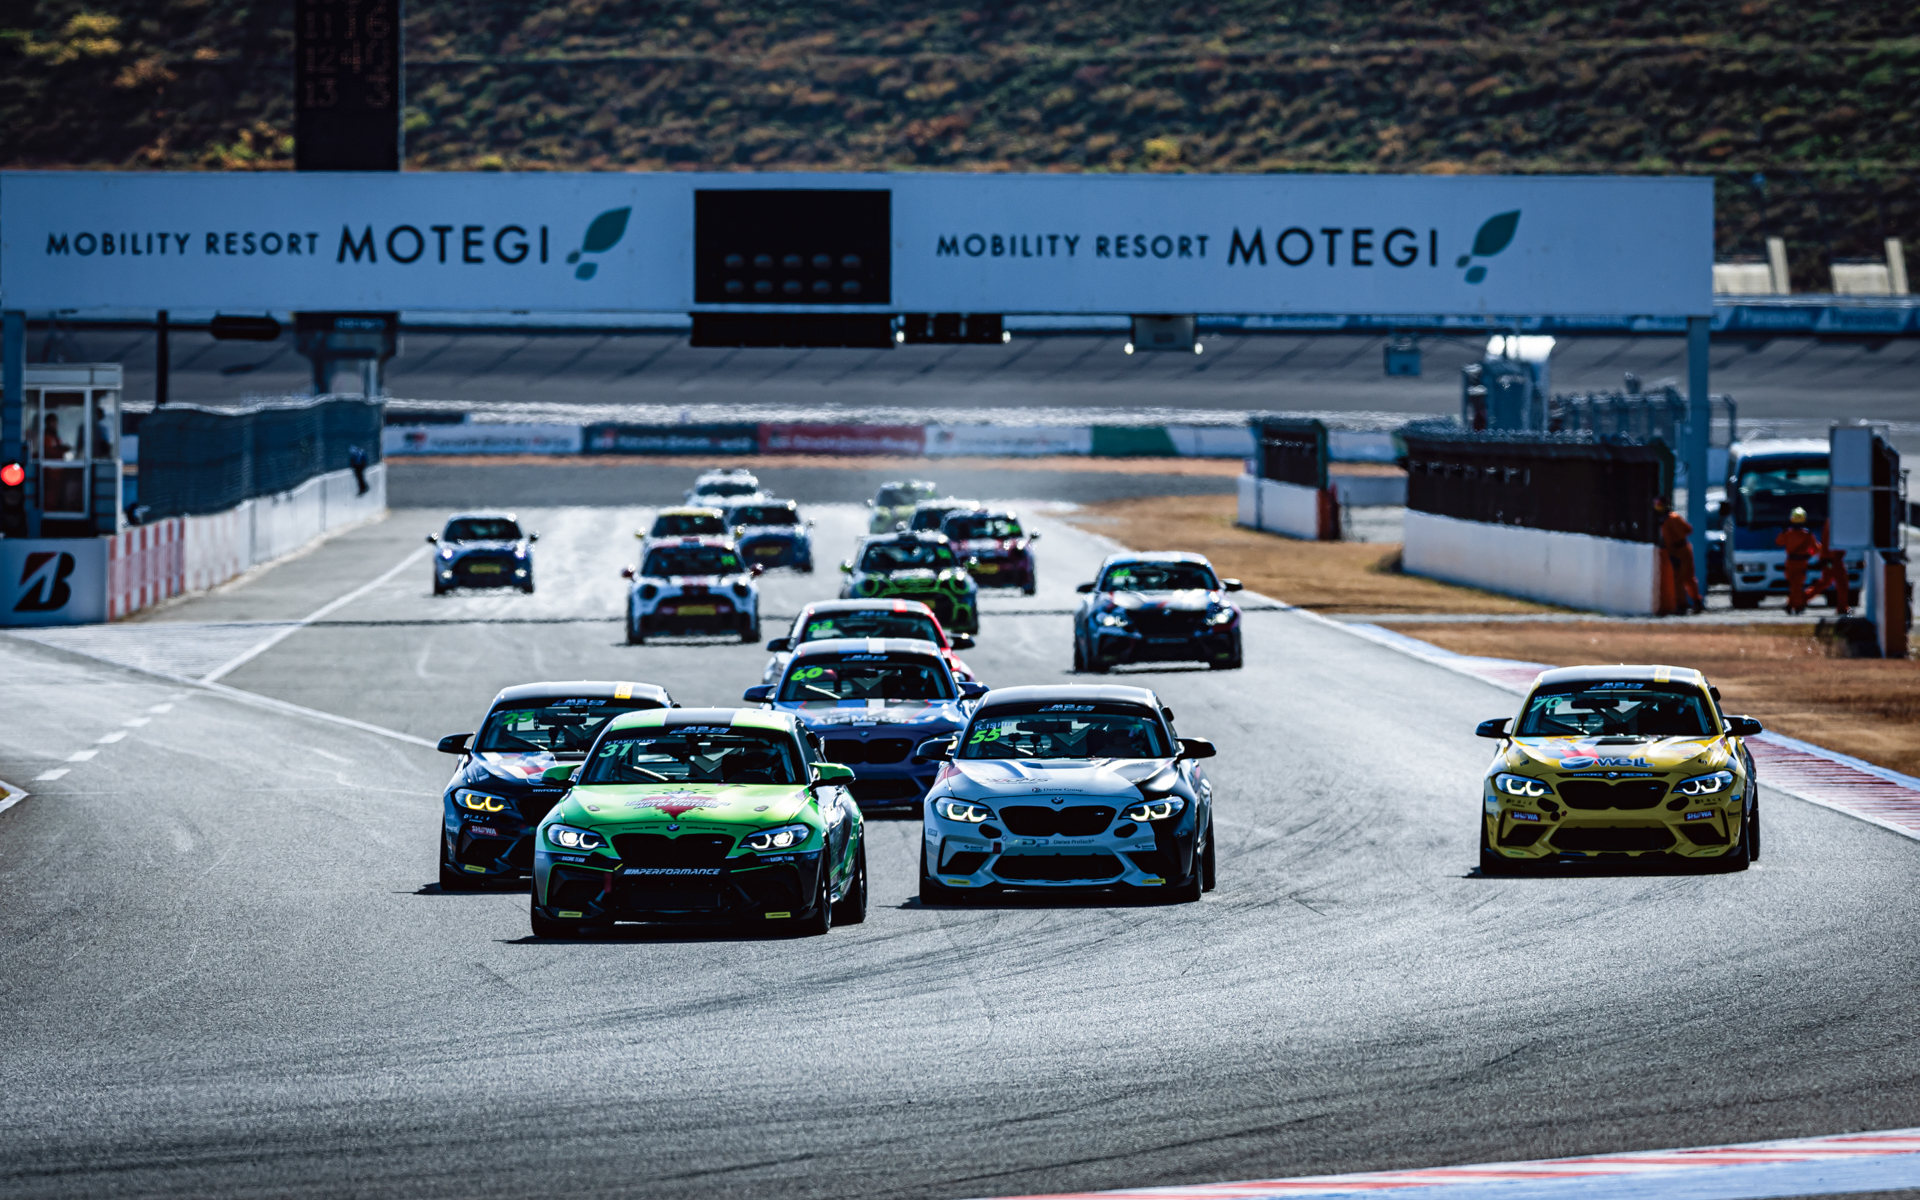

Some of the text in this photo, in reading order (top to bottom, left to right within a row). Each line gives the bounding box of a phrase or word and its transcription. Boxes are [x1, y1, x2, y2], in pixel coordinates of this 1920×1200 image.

[45, 224, 549, 265] MOBILITY RESORT MOTEGI
[936, 225, 1439, 268] MOBILITY RESORT MOTEGI
[790, 667, 824, 681] 60
[1530, 696, 1563, 712] 70
[502, 712, 535, 726] 25
[969, 728, 1002, 744] 55
[598, 743, 633, 758] 31
